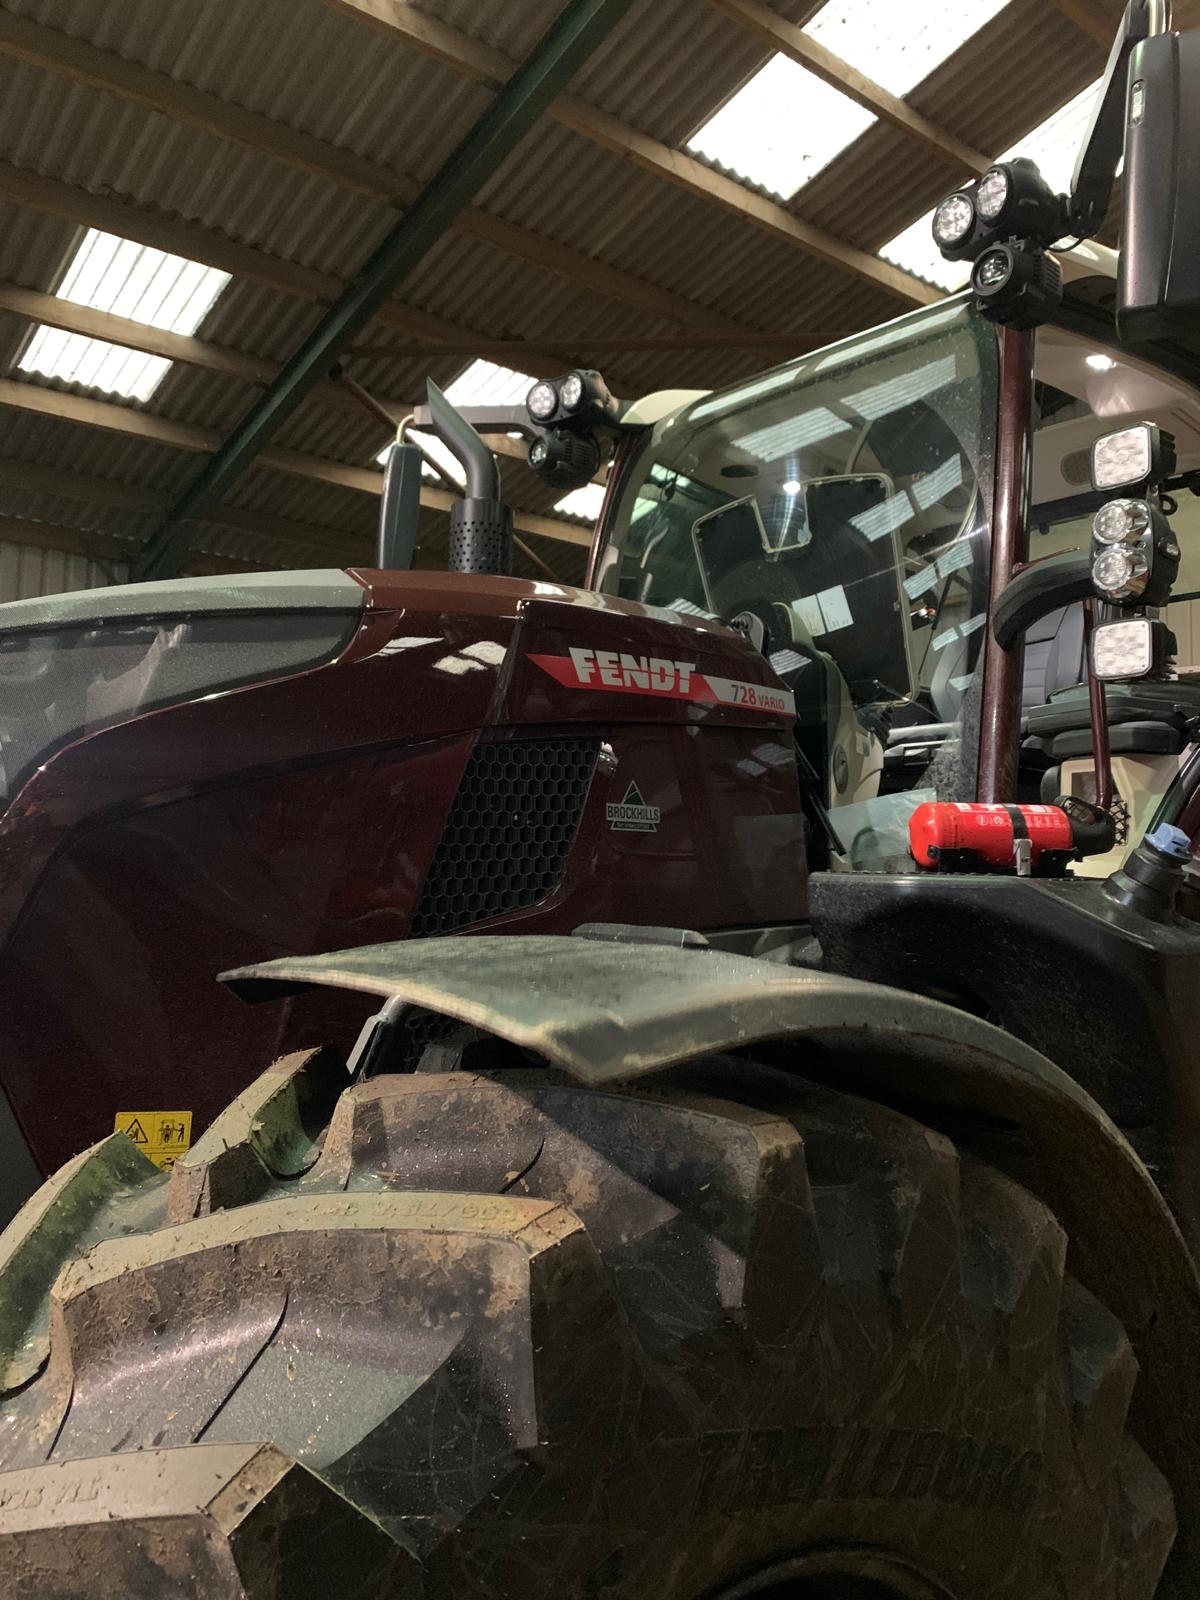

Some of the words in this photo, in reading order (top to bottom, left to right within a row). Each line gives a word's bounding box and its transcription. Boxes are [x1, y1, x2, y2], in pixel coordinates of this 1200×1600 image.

[568, 647, 696, 694] FENDT
[731, 684, 757, 705] 728
[758, 696, 785, 710] VARIO
[607, 805, 659, 821] BROCKHILLS
